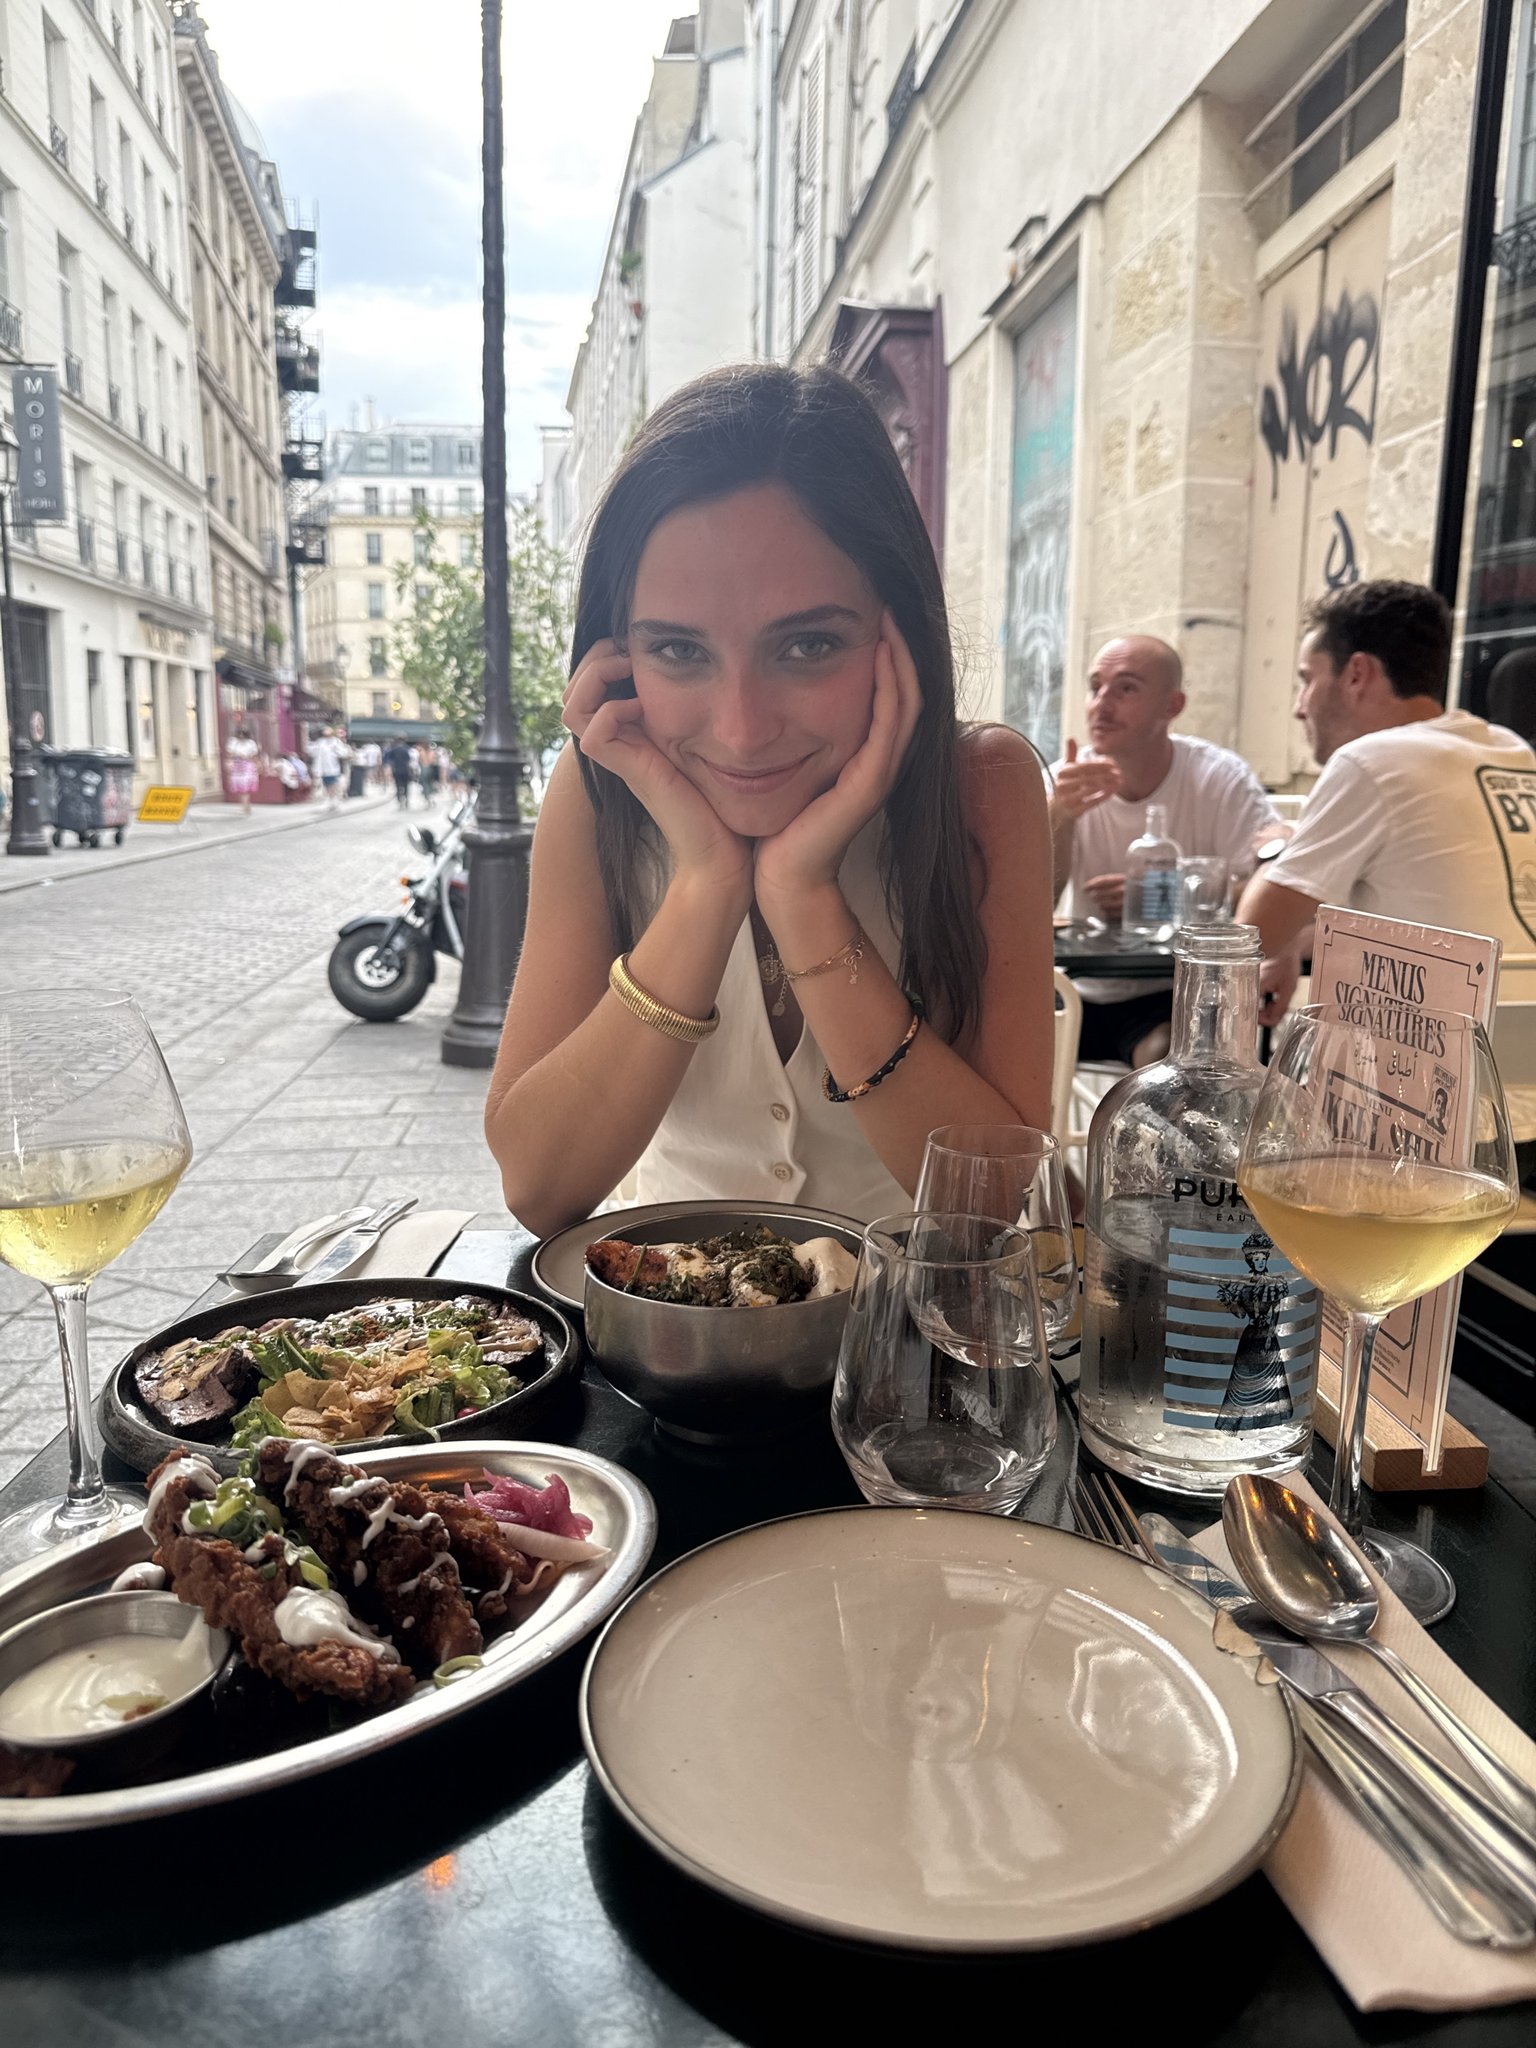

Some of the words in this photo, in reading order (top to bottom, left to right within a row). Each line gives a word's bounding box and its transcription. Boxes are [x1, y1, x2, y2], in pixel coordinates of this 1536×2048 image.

[23, 376, 47, 488] MORIS
[1360, 951, 1427, 1005] MENUS
[1338, 1005, 1447, 1059] SIGNATURES
